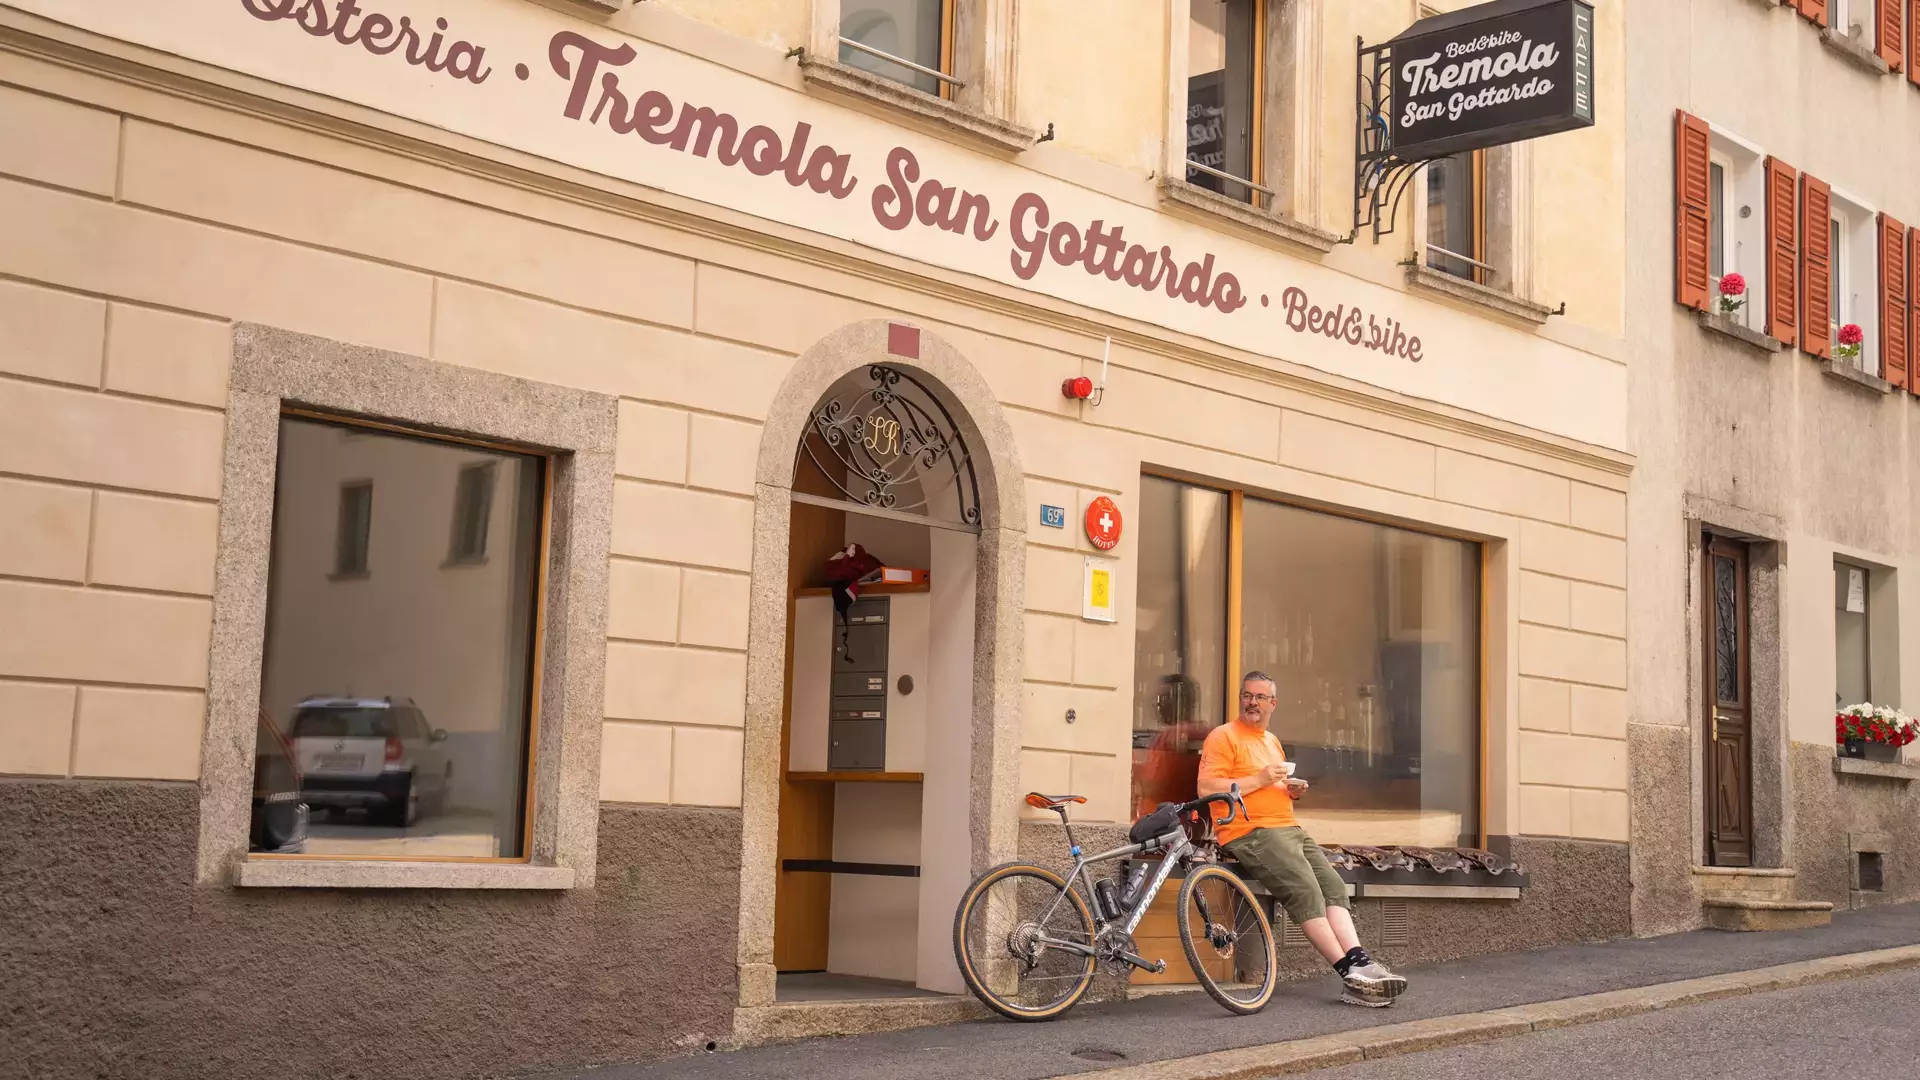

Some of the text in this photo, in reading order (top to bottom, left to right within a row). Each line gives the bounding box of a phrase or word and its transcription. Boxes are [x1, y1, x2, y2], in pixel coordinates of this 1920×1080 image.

[1401, 39, 1560, 98] Tremola
[1445, 30, 1523, 58] Bed&bike
[1400, 76, 1555, 128] San Gottardo
[548, 30, 857, 199] Tremola
[871, 146, 999, 242] San
[1010, 192, 1246, 313] Gottardo
[1047, 508, 1060, 523] 69
[1093, 535, 1116, 549] HOTEL
[1127, 855, 1175, 935] cannondale
